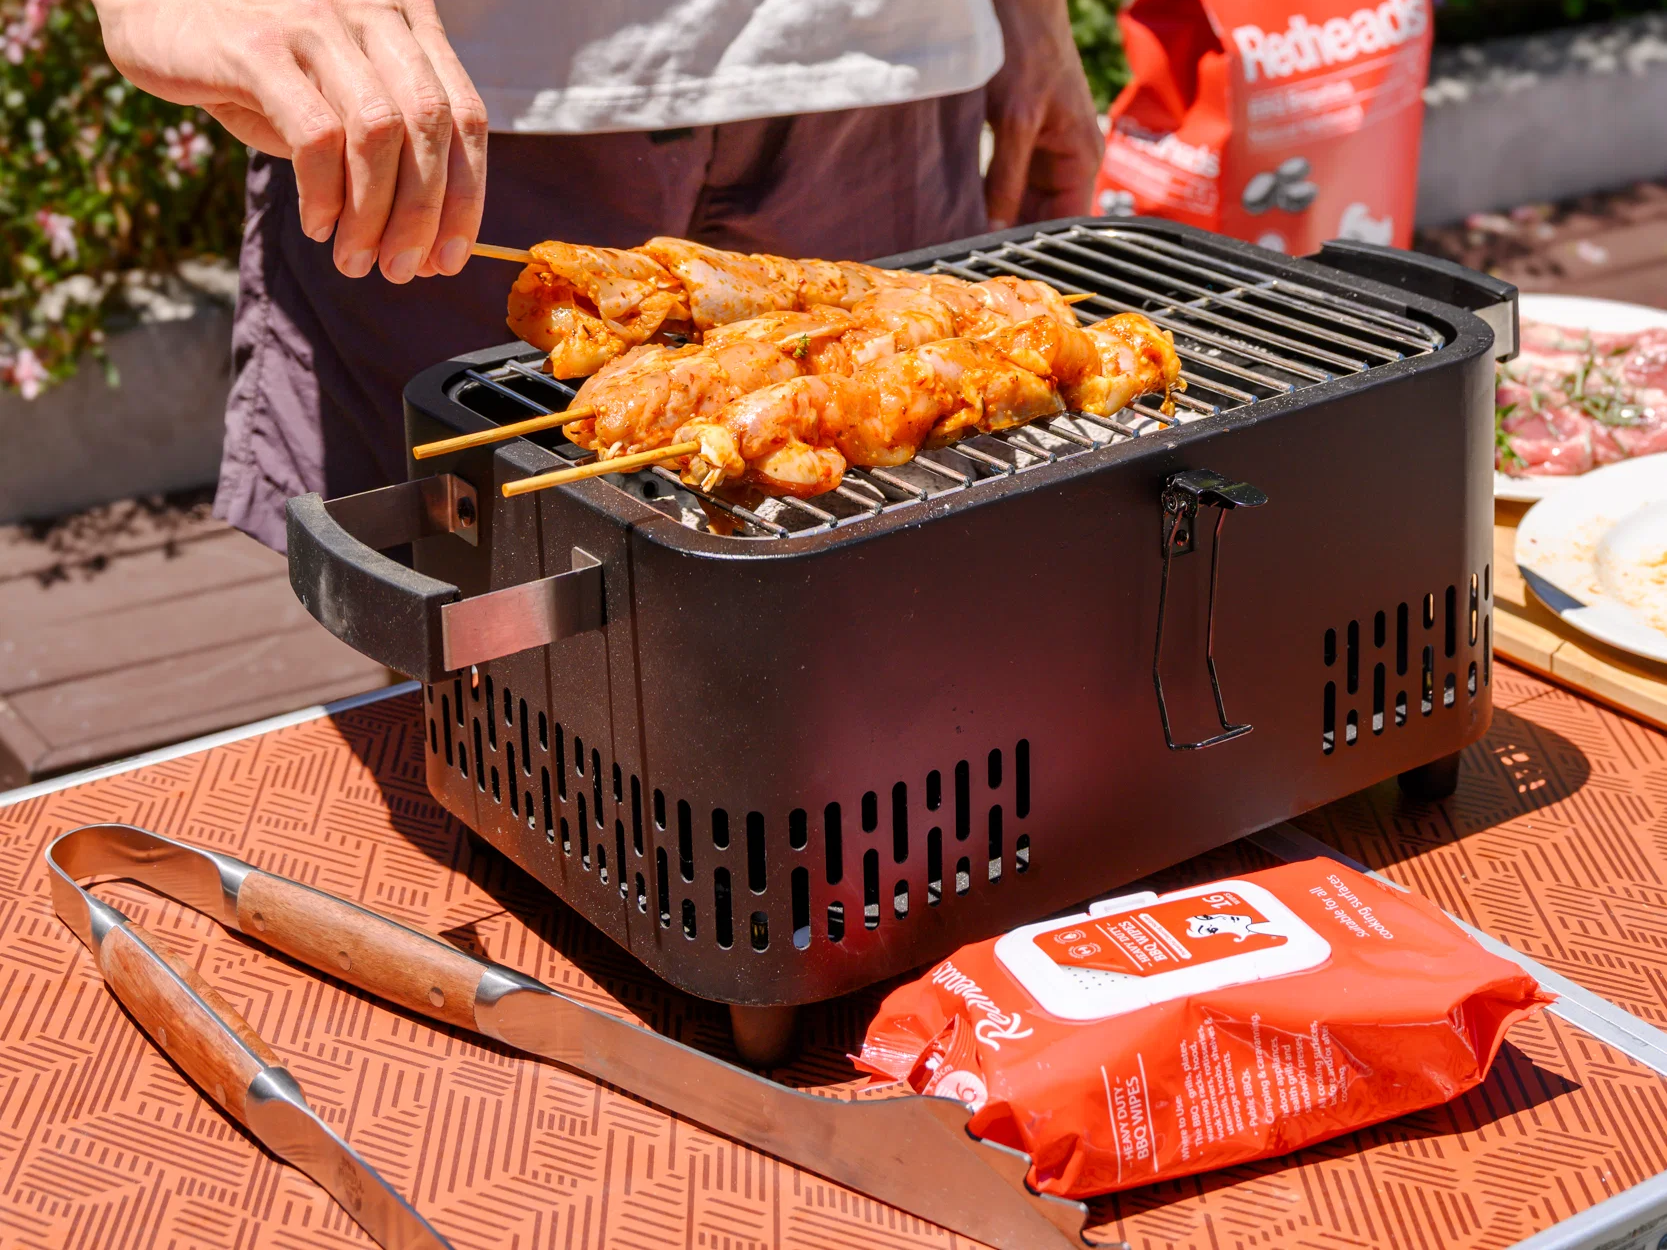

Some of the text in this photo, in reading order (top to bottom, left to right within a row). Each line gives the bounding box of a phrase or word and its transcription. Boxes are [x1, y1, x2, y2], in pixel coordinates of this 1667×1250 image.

[1202, 895, 1232, 909] 16
[1309, 886, 1370, 938] Suitable for all
[1326, 874, 1394, 939] cooking surfaces
[1107, 925, 1130, 943] DUTY
[1118, 920, 1150, 945] WIPES
[1124, 940, 1151, 963] HEAVY
[1143, 942, 1168, 962] BBQ
[1180, 1039, 1192, 1072] plates,
[1204, 1016, 1235, 1136] utensils, knobs, shelves &
[1257, 1070, 1266, 1079] &
[1189, 1041, 1214, 1143] warming racks, hood,
[1207, 1076, 1220, 1118] burners,
[1223, 1050, 1244, 1132] storage cabinets.
[1241, 1068, 1258, 1127] Public BBQs.
[1281, 1044, 1300, 1117] health grills and
[1297, 1069, 1312, 1114] sandwich
[1315, 1060, 1326, 1097] cooking
[1125, 1075, 1150, 1160] BBQ WIPES
[1190, 1105, 1201, 1128] BBQ
[1261, 1079, 1275, 1124] Camping
[1113, 1087, 1134, 1161] HEAVY DUTY
[1175, 1094, 1190, 1160] Where to Use:
[1195, 1128, 1204, 1147] The
[1214, 1117, 1225, 1140] wok
